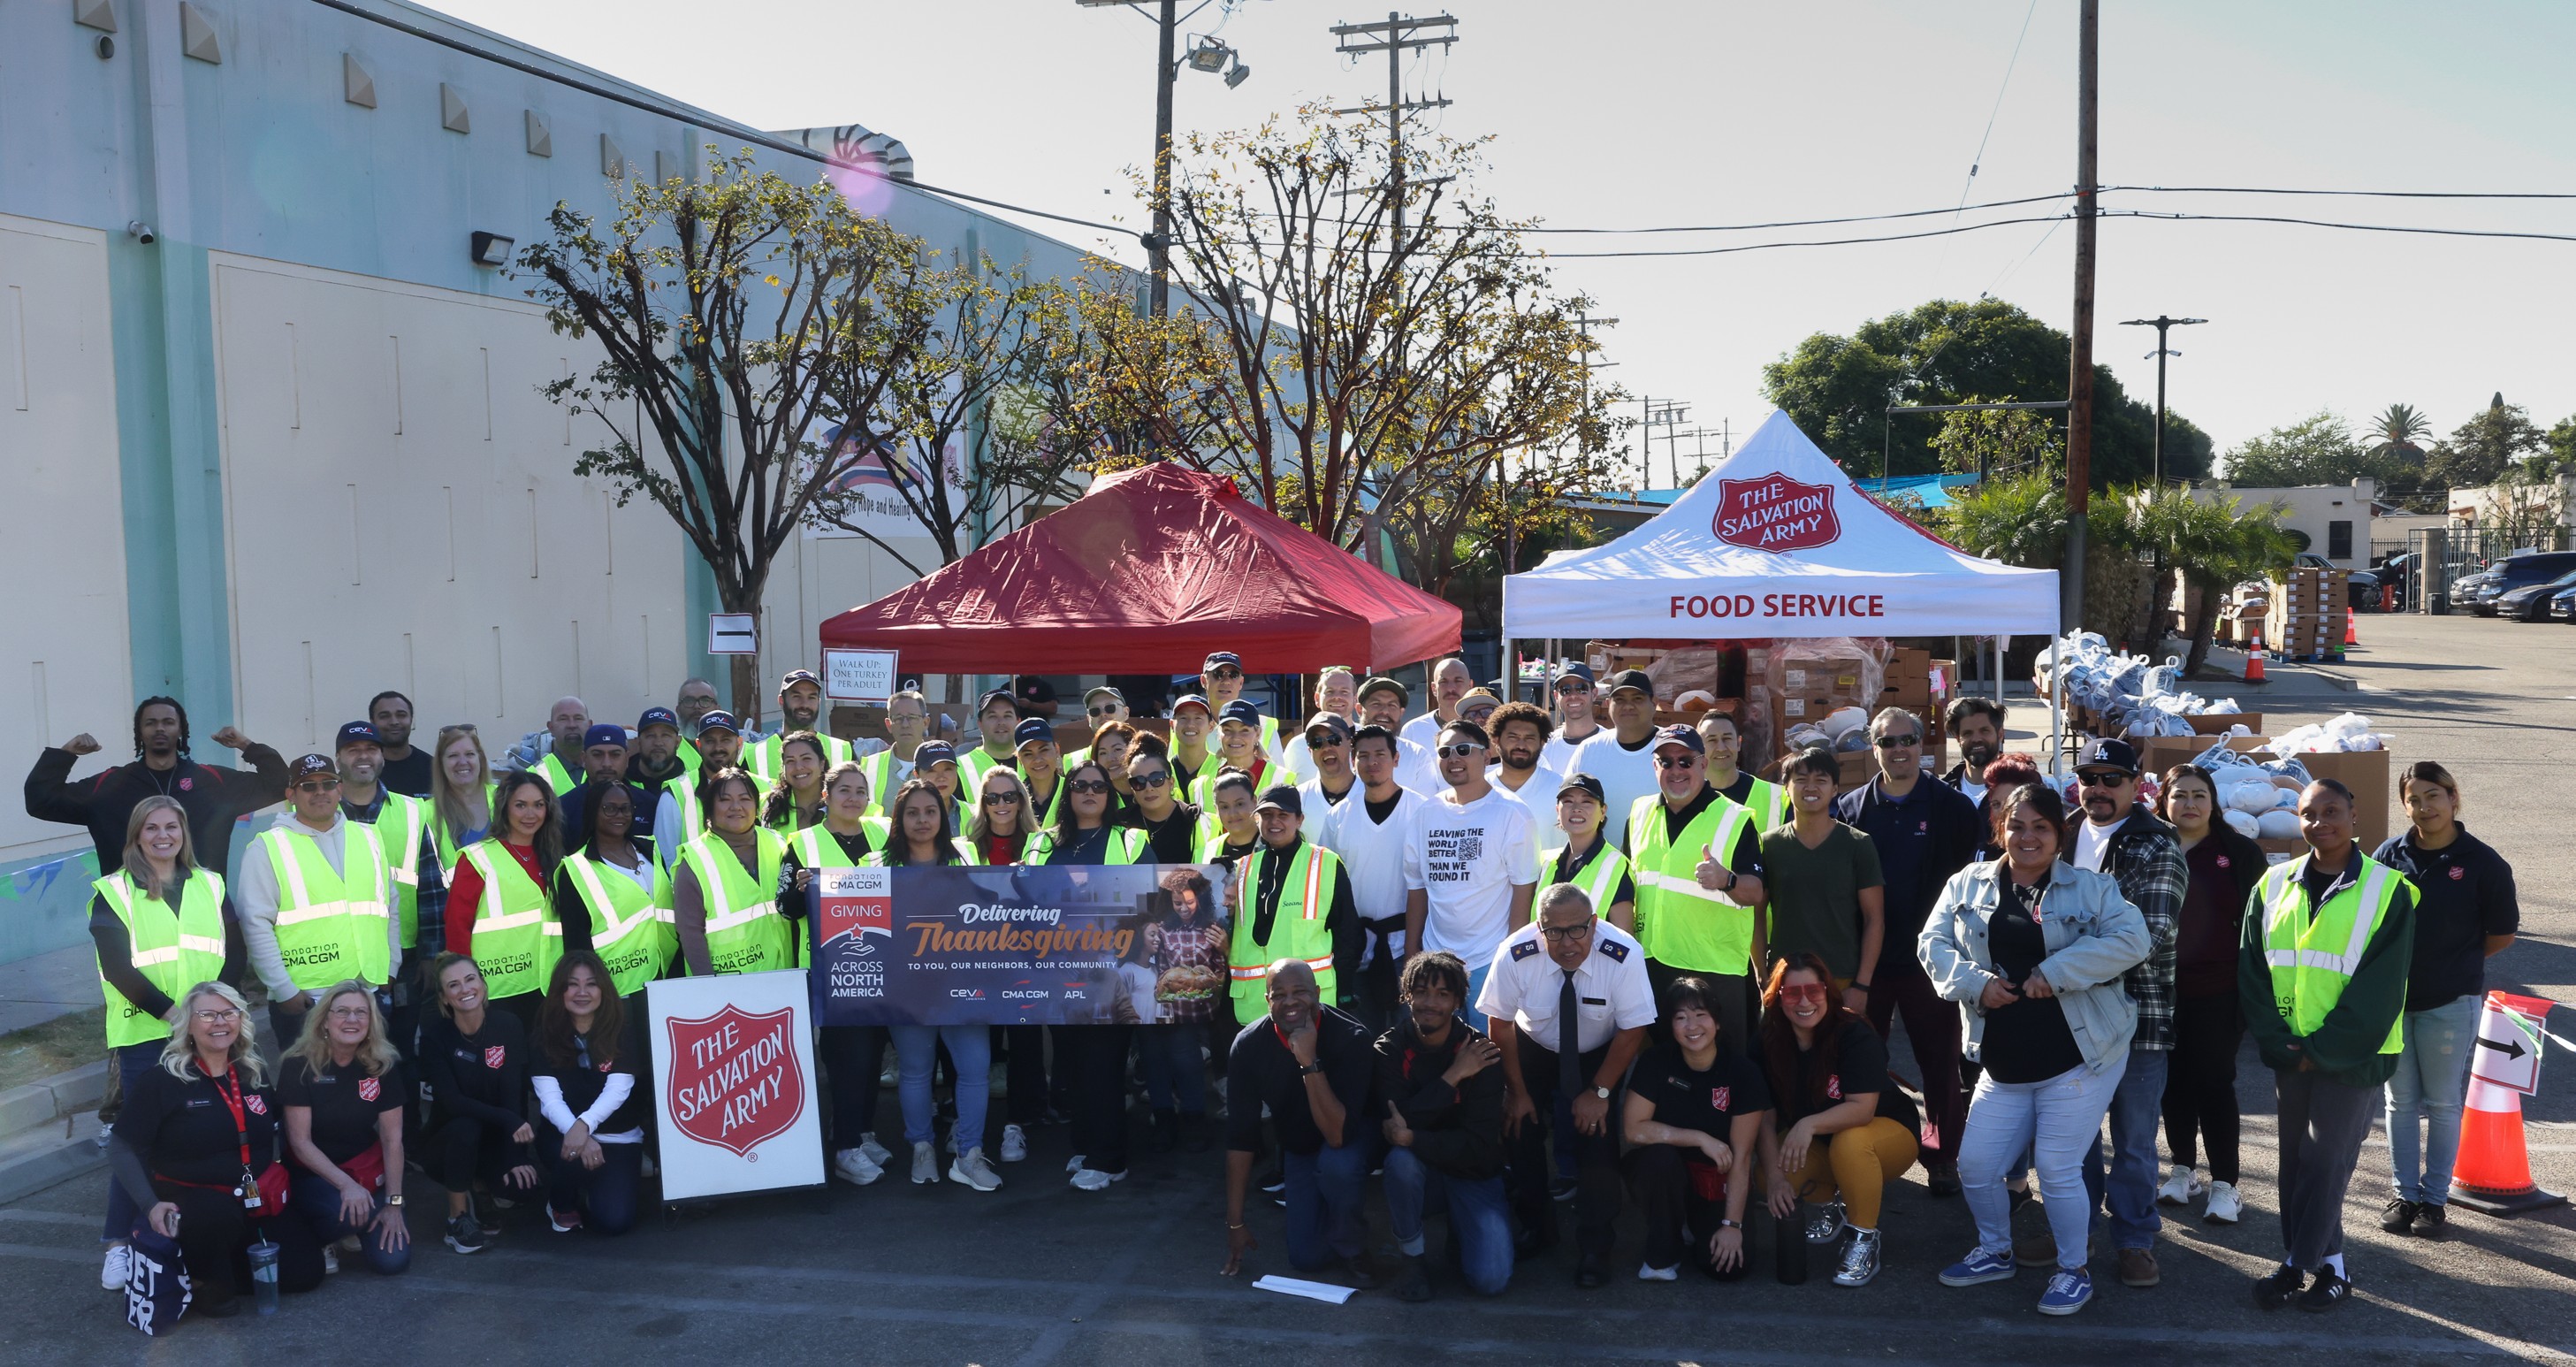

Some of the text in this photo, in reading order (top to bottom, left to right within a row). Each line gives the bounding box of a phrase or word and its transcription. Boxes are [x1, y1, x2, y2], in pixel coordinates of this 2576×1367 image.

[1739, 482, 1785, 508] THE
[876, 497, 887, 515] and
[888, 497, 911, 521] Healing
[1723, 492, 1824, 536] SALVATION
[1758, 515, 1822, 546] ARMY
[1671, 594, 1884, 617] FOOD SERVICE
[839, 659, 881, 668] WALK UP:
[834, 668, 888, 679] ONE TURKEY
[2094, 744, 2108, 760] LA
[1429, 828, 1484, 838] LEAVING THE
[1429, 862, 1450, 871] THAN
[1429, 872, 1470, 882] FOUND IT
[831, 905, 882, 917] GIVING
[958, 903, 1061, 925] Delivering
[906, 921, 1135, 958] Thanksgiving
[309, 951, 339, 965] CGM
[738, 951, 765, 966] CGM
[505, 960, 533, 974] CGM
[831, 961, 883, 973] ACROSS
[974, 961, 1032, 970] NEIGHBORS,
[831, 974, 883, 987] NORTH
[831, 988, 884, 997] AMERICA
[1002, 990, 1048, 999] CMA CGM
[1064, 990, 1086, 999] APL
[691, 1020, 740, 1070] THE
[678, 1023, 785, 1122] SALVATION
[720, 1065, 783, 1138] ARMY
